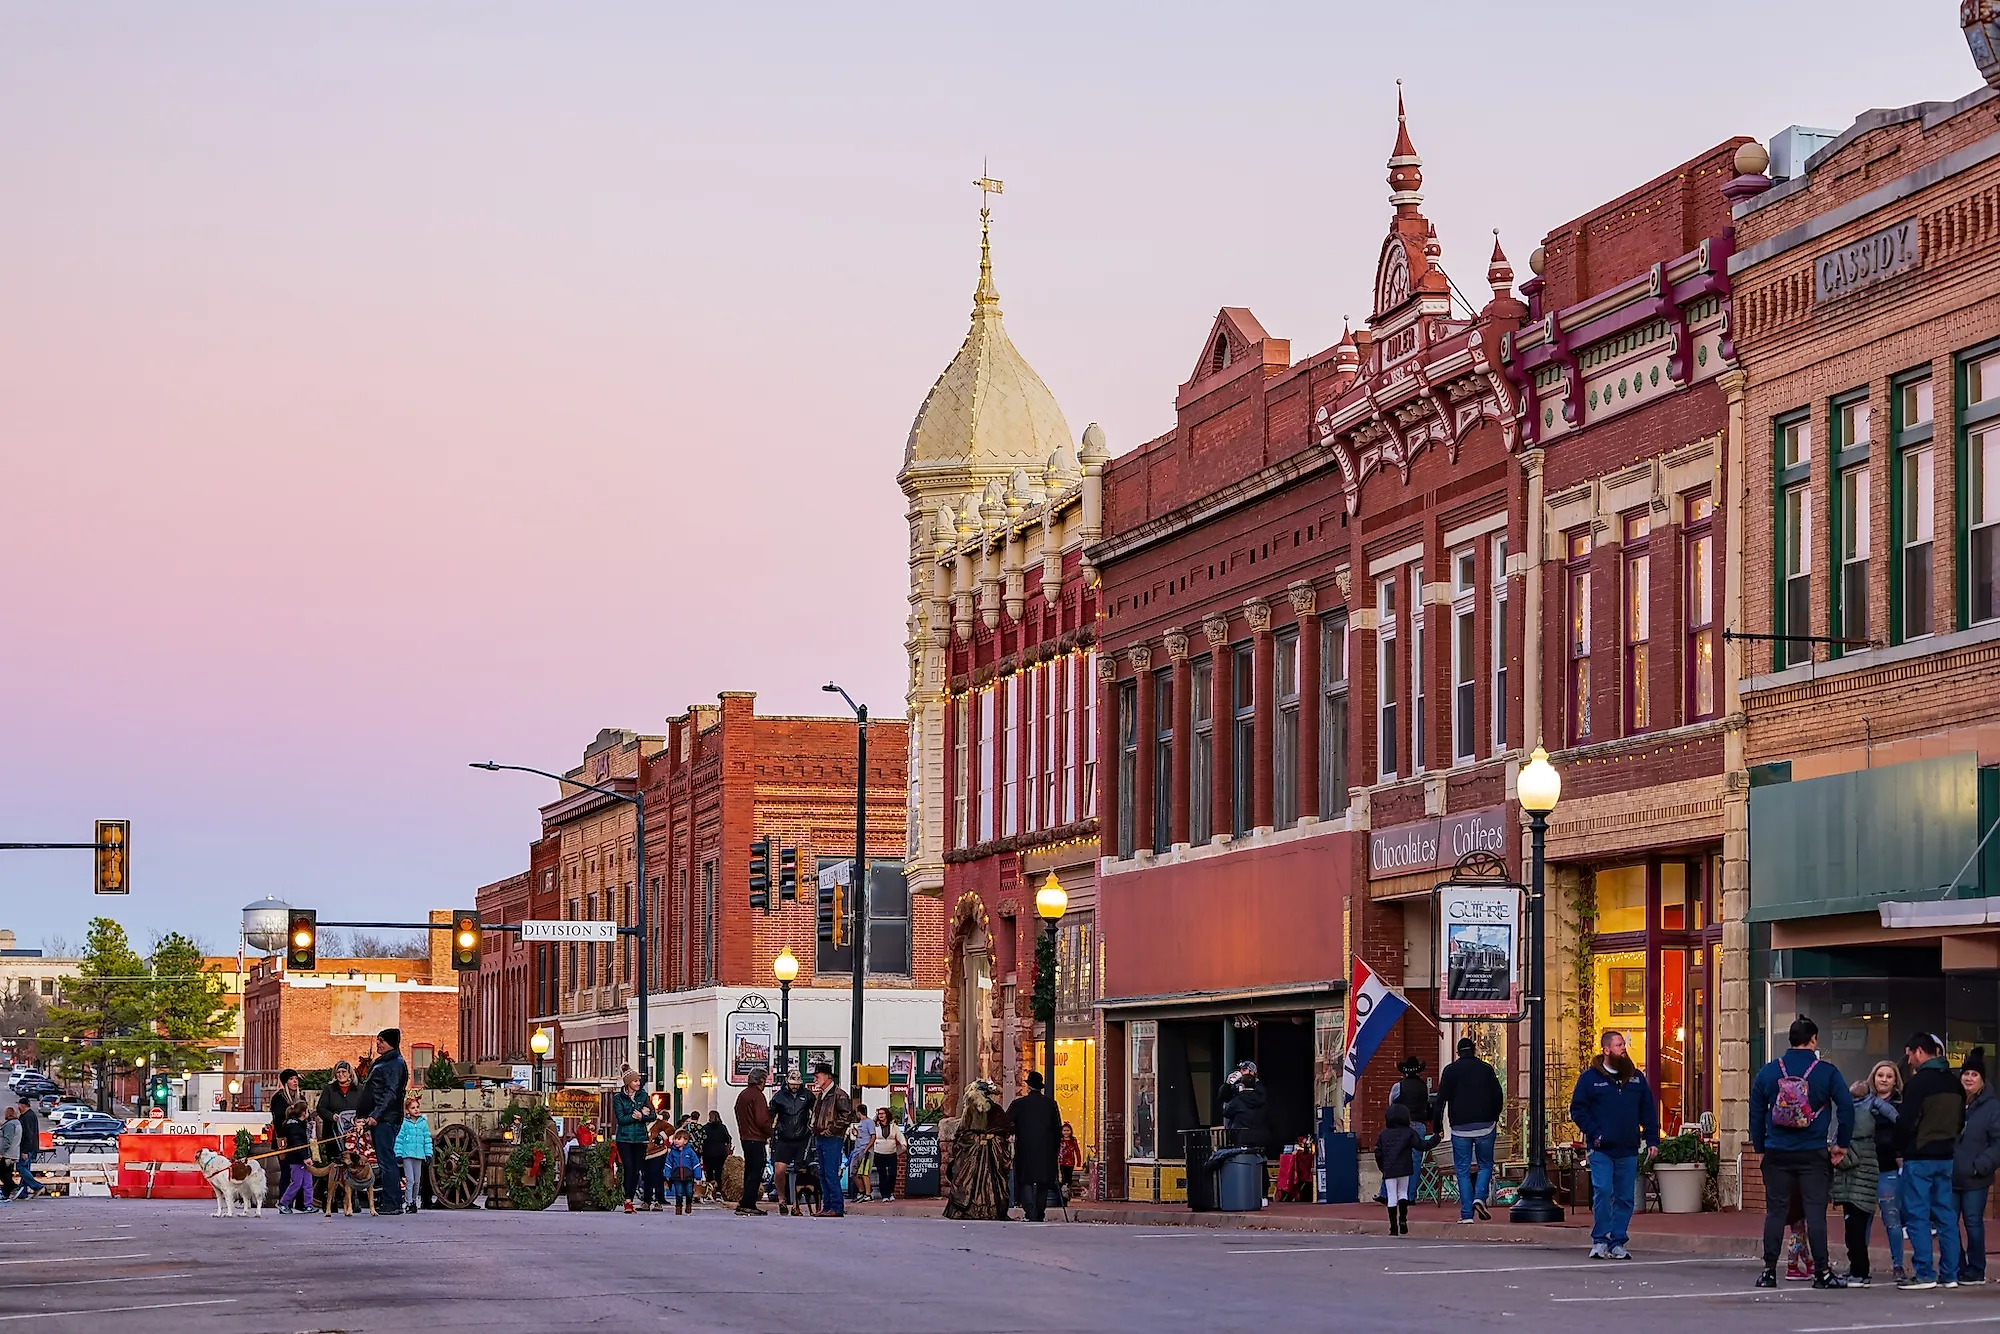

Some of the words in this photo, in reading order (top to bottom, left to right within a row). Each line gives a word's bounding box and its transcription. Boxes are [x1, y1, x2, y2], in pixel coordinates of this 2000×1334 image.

[1386, 327, 1415, 362] ADLER
[1372, 831, 1437, 871] Chocolates
[1452, 817, 1503, 857] Coffees
[1449, 901, 1510, 920] GUTHRIE
[523, 924, 592, 936] DIVISION
[600, 926, 616, 936] ST
[169, 1125, 197, 1134] ROAD
[908, 1136, 939, 1146] COUNTRY
[909, 1146, 938, 1155] CORNER
